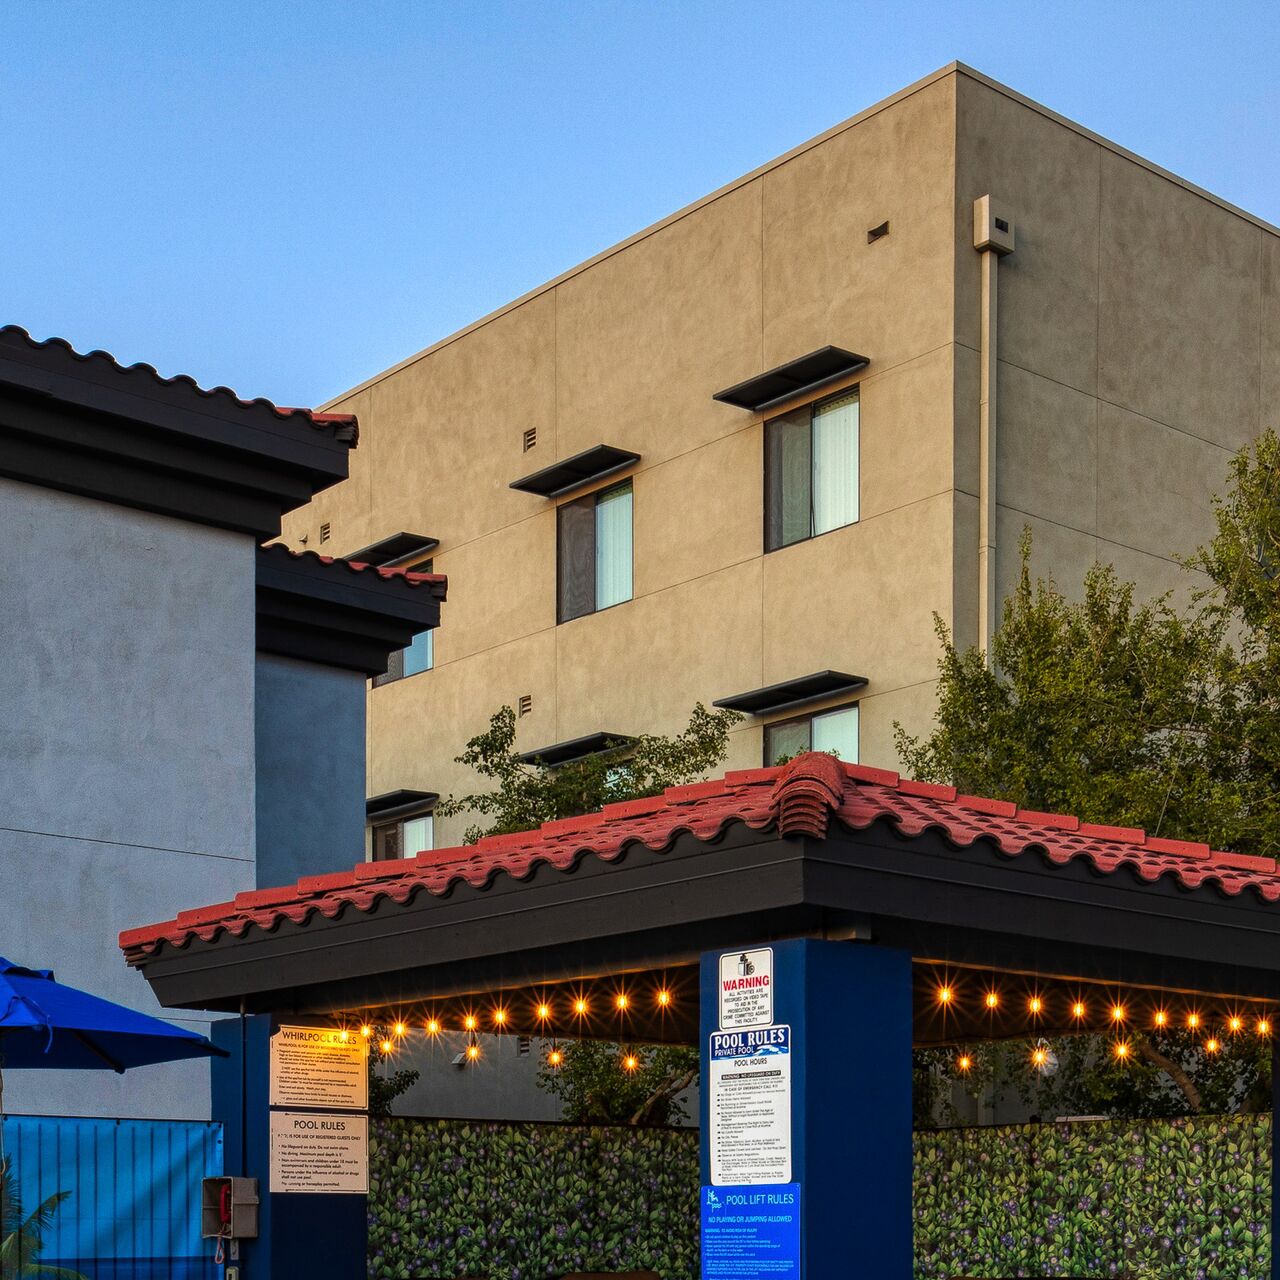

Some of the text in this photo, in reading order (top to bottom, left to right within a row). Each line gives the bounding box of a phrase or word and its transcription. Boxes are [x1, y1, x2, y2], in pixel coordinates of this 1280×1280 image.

[723, 975, 770, 991] WARNING
[282, 1031, 332, 1043] WHIRLPOOL
[715, 1029, 785, 1049] POOL RULES
[715, 1046, 754, 1057] PRIVATE POOL
[734, 1057, 767, 1067] POOL HOURS
[294, 1120, 346, 1131] POOL RULES
[726, 1193, 794, 1205] POOL LIFT RULES
